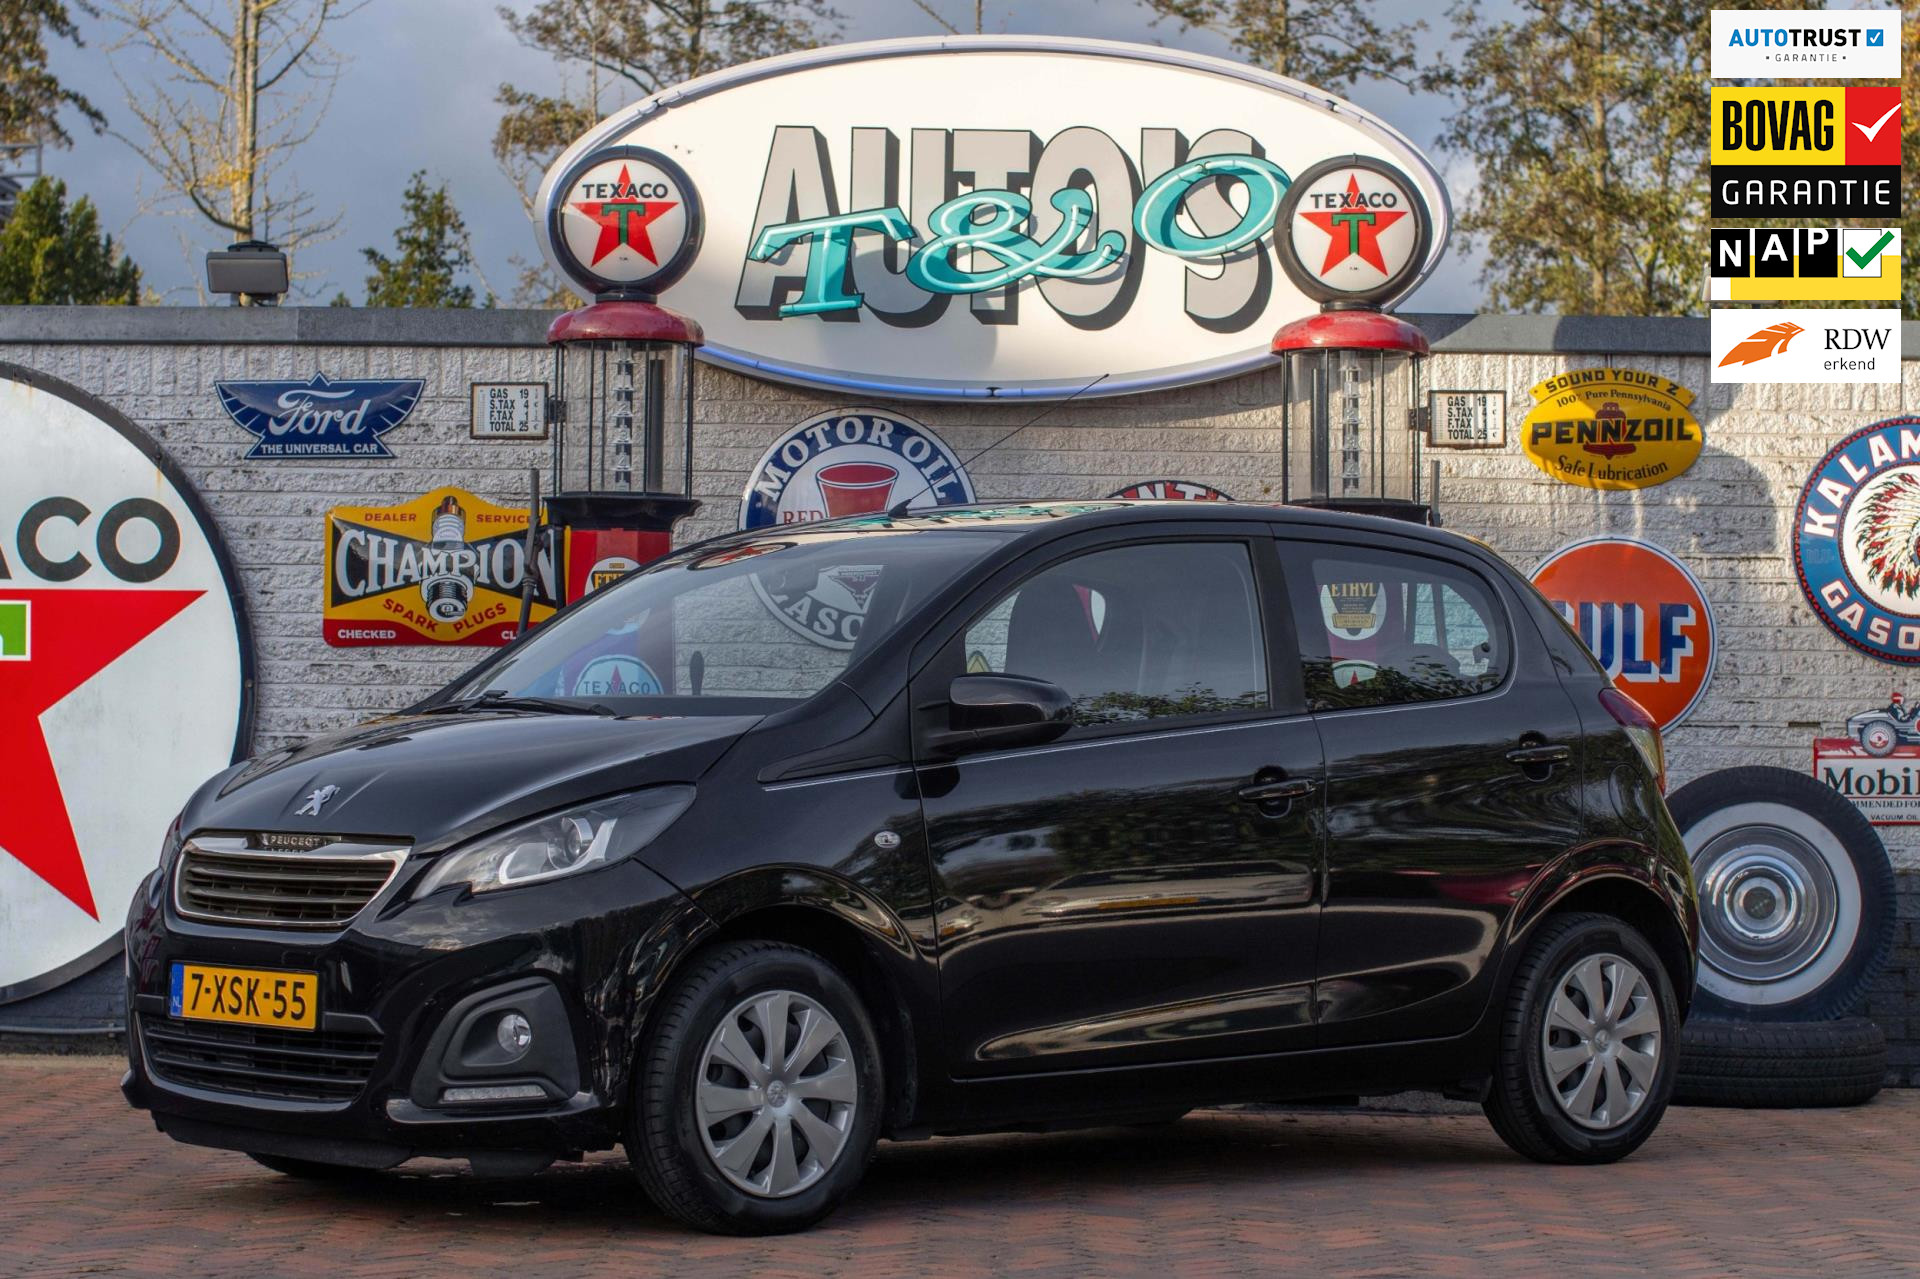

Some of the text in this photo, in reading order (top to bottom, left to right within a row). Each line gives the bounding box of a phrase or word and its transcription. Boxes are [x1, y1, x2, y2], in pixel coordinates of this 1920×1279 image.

[582, 183, 668, 199] TEXACO
[1310, 192, 1397, 208] TEXACO
[734, 125, 1272, 332] AUTO'S
[1545, 369, 1680, 396] SOUND YOUR Z
[490, 388, 508, 399] GAS
[519, 388, 529, 399] 19
[1585, 390, 1608, 400] Pure
[1610, 389, 1671, 412] Pennsylvania
[490, 399, 515, 410] S.TAX
[1447, 396, 1466, 407] GAS
[1477, 396, 1487, 407] 19
[268, 389, 371, 436] Ford
[490, 410, 514, 421] F.TAX
[1447, 407, 1473, 418] S.TAX
[490, 421, 516, 432] TOTAL
[519, 421, 529, 432] 25
[1447, 418, 1472, 429] F.TAX
[1447, 429, 1475, 440] TOTAL
[1477, 429, 1488, 440] 25
[1531, 418, 1693, 445] PENNZOIL
[261, 443, 377, 454] THE UNIVERSAL CAR
[756, 417, 958, 501] MOTOR OIL
[1554, 455, 1668, 480] Safe Lubrication
[365, 513, 416, 522] DEALER
[476, 514, 541, 524] SERVIC
[0, 496, 181, 584] CO
[383, 598, 507, 633] SPARK PLUGS
[1820, 579, 1920, 650] GASO
[338, 629, 396, 639] CHECKED
[583, 681, 650, 695] TEXACO
[270, 835, 320, 847] PEUGEOT
[191, 973, 306, 1020] 7-XSK-55
